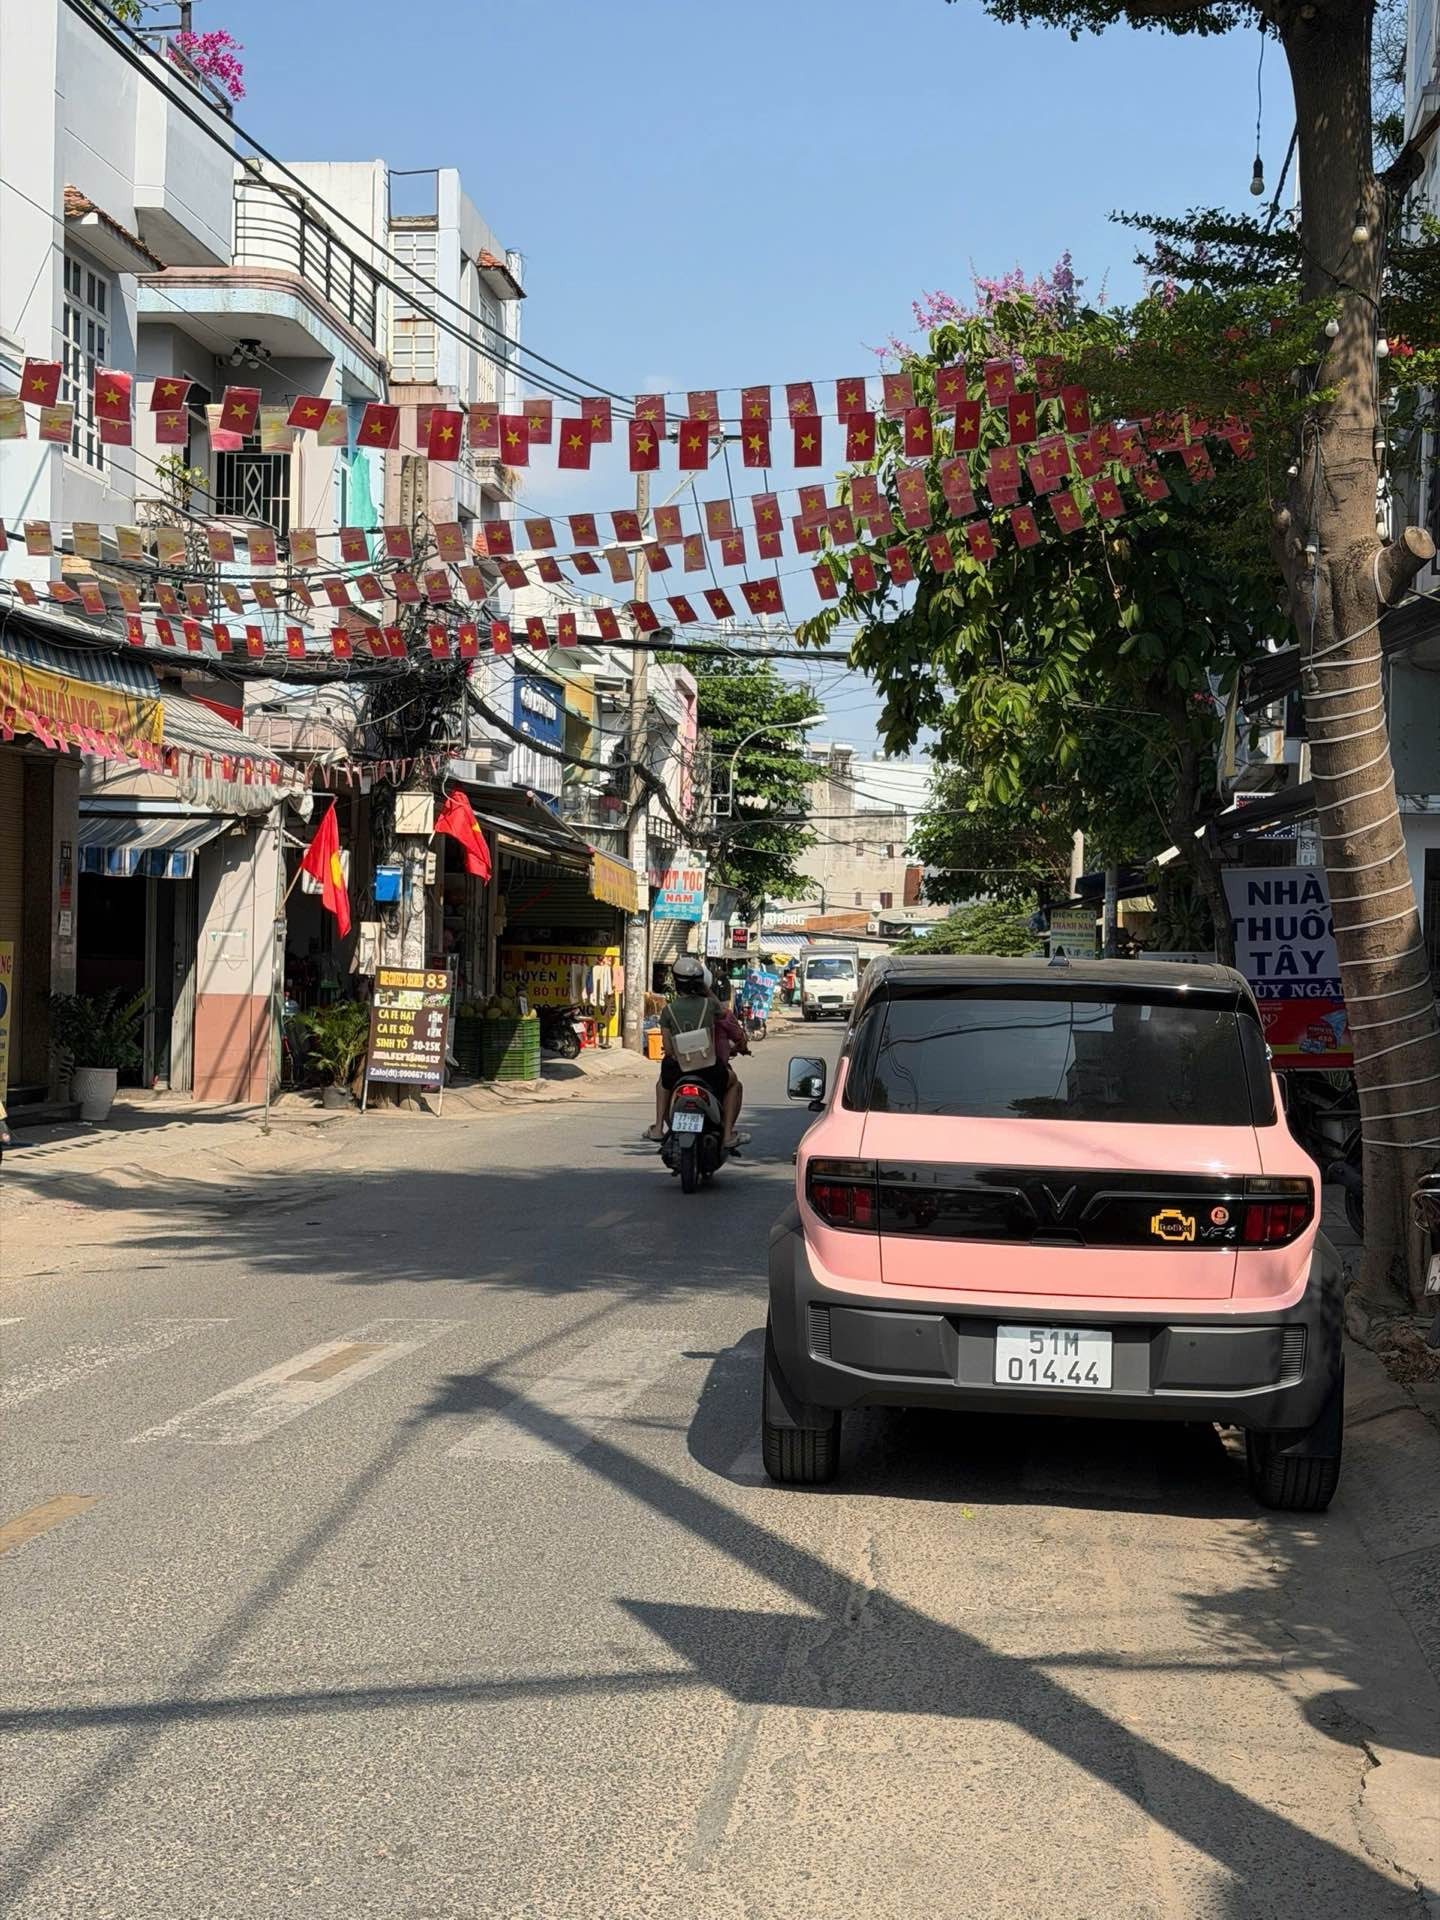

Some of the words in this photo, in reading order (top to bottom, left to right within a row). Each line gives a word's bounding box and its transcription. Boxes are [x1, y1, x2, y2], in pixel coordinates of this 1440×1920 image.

[1247, 873, 1325, 905] NHÀ
[1250, 944, 1325, 976] TÂY
[426, 973, 448, 990] 83
[1250, 981, 1283, 998] ÙY
[376, 1038, 395, 1048] SINH
[1029, 1330, 1079, 1356] 51M
[1008, 1357, 1099, 1385] 014.44
